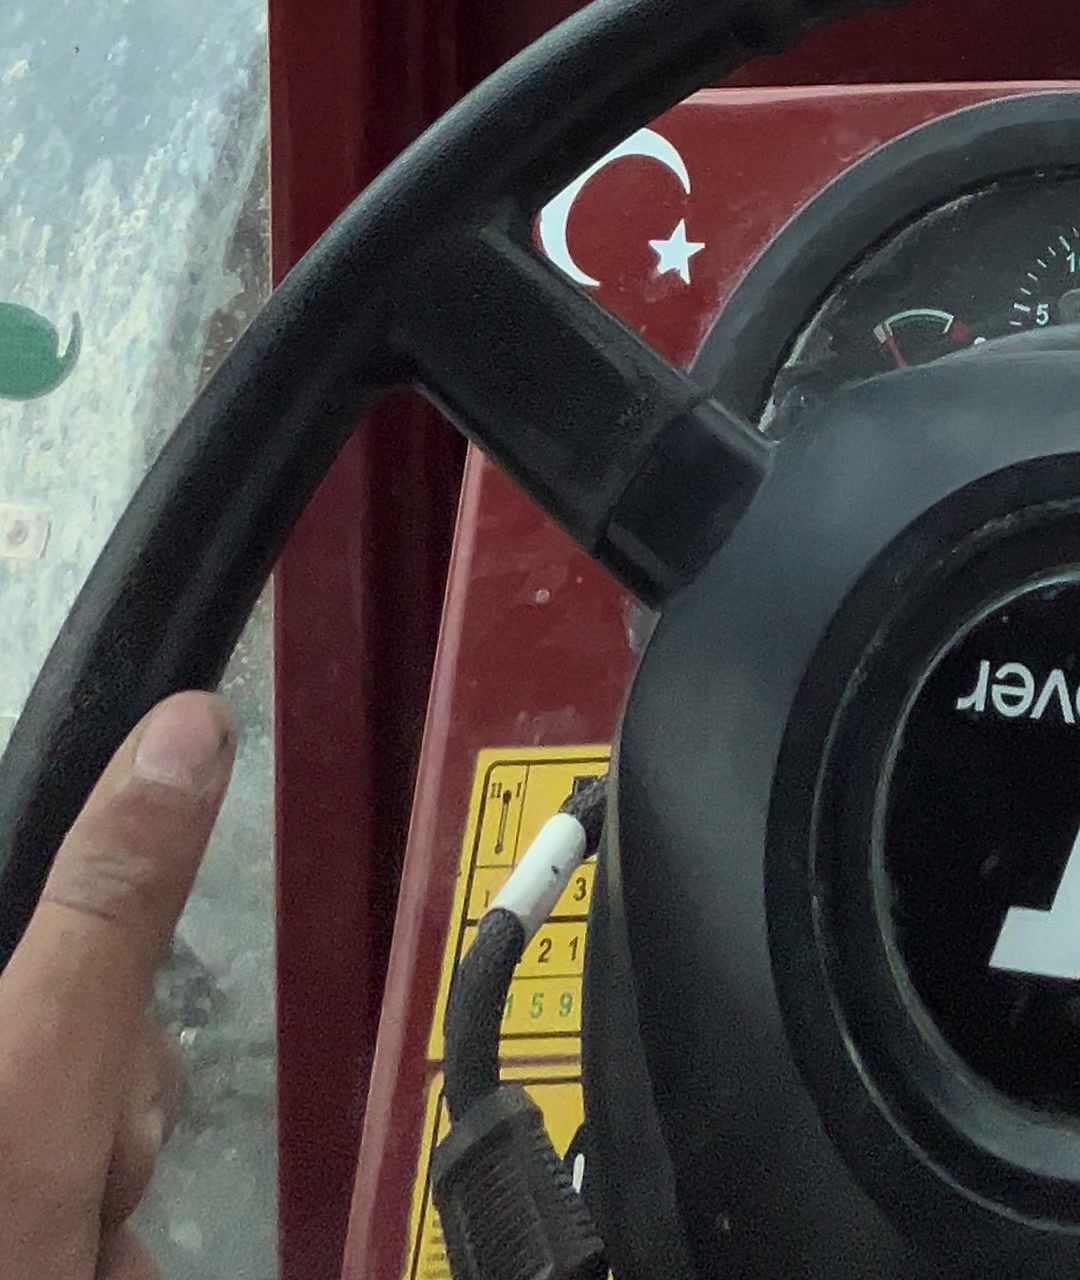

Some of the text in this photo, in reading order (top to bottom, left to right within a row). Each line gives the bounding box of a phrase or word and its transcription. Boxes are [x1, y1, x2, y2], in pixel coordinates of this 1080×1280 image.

[1035, 303, 1049, 326] 5
[573, 877, 587, 901] 3
[538, 936, 578, 963] 2 1
[531, 992, 544, 1019] 5
[559, 992, 573, 1017] 9
